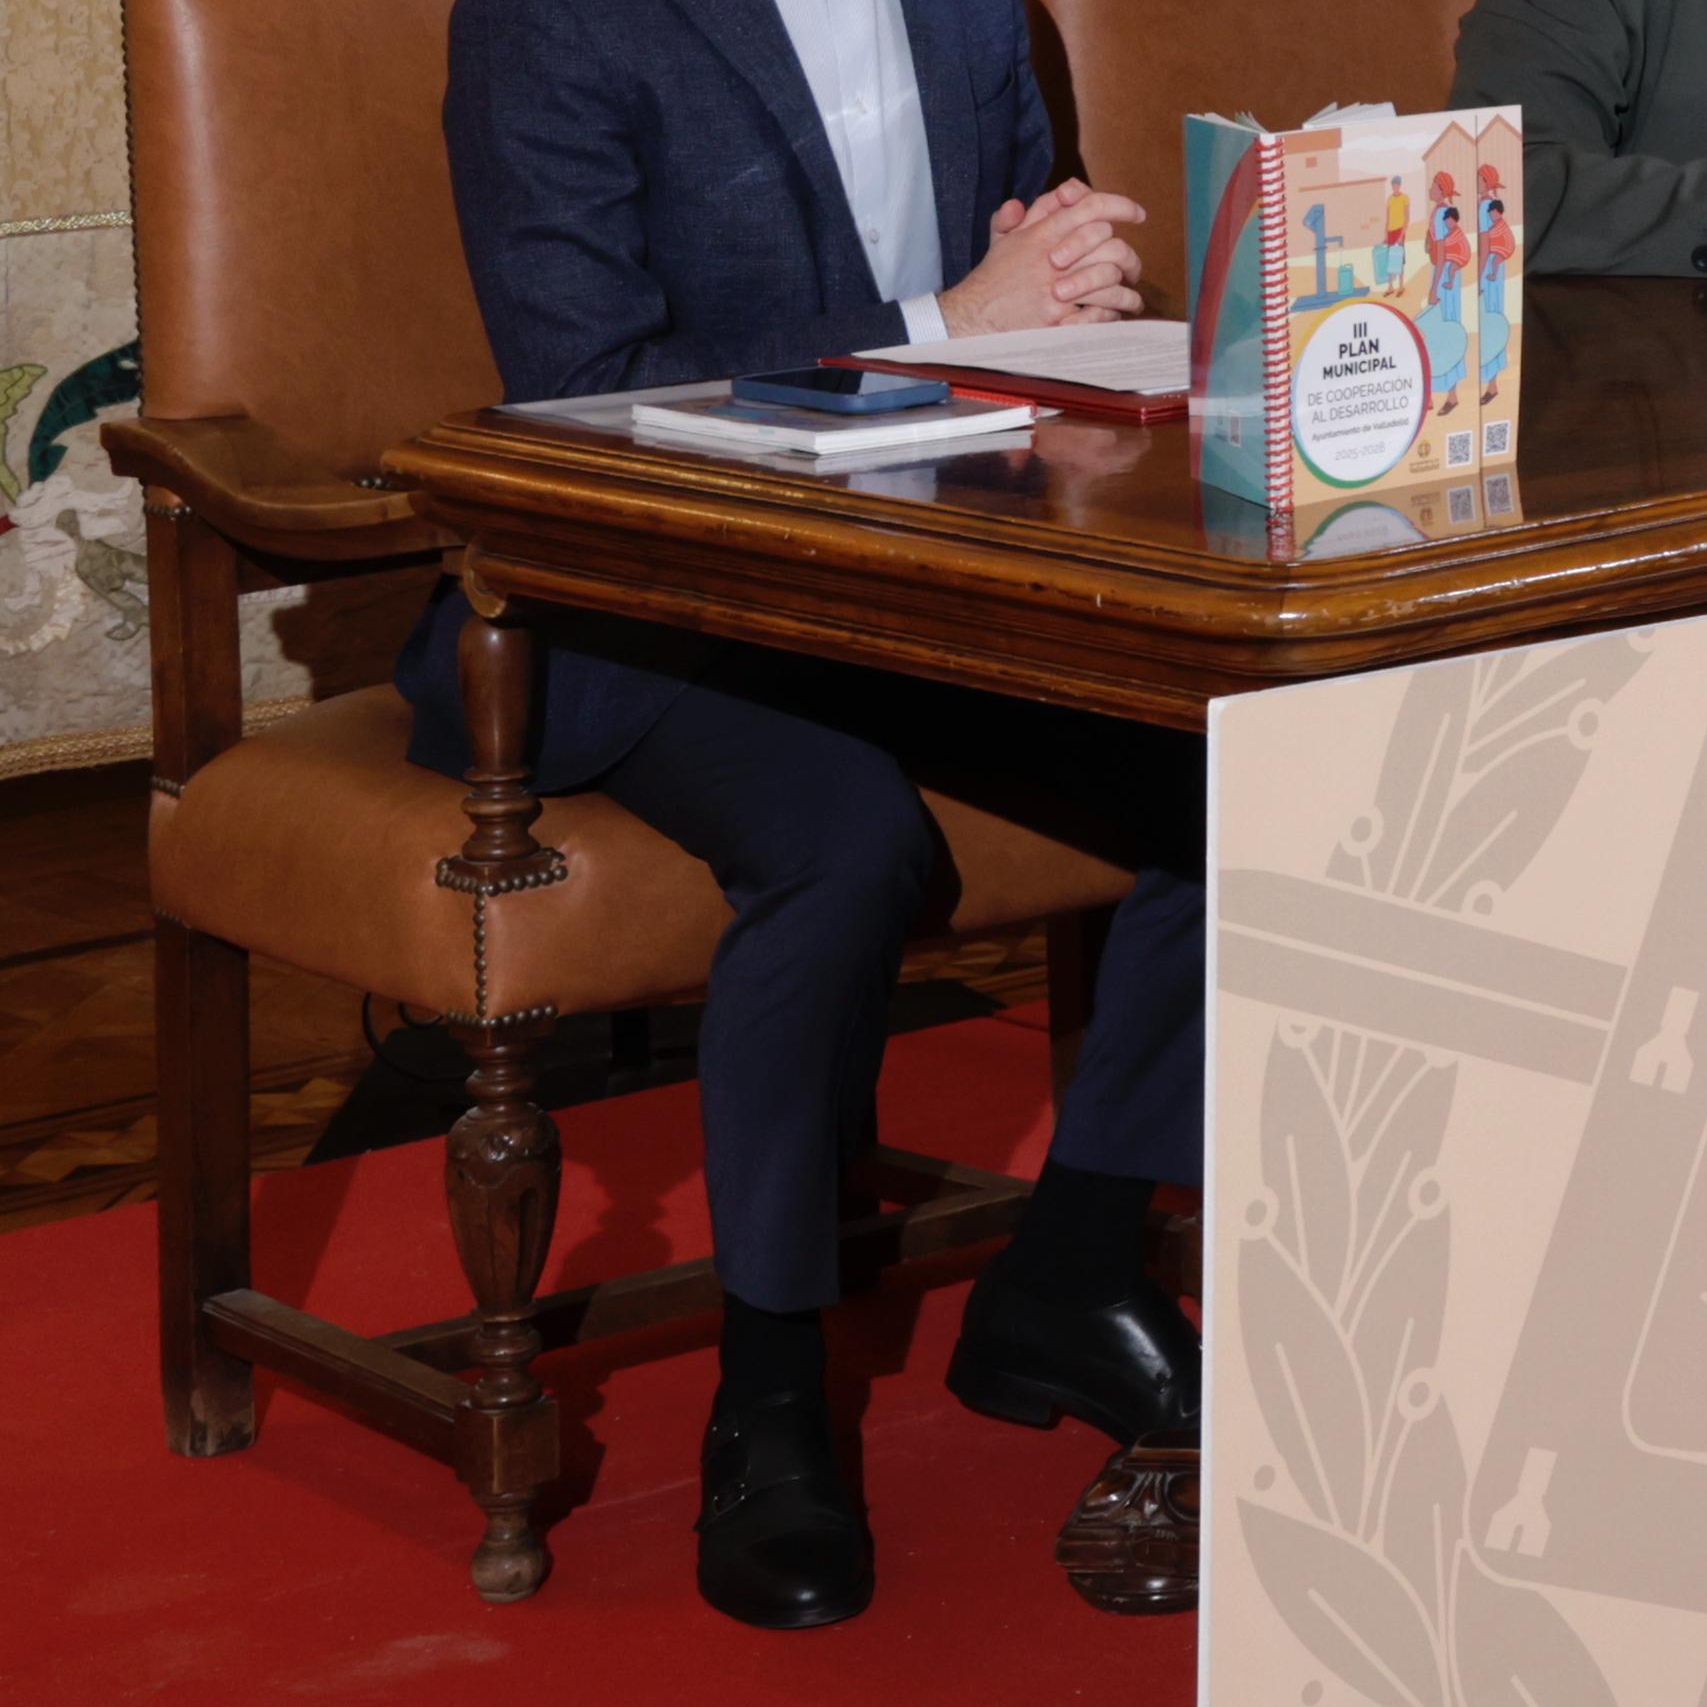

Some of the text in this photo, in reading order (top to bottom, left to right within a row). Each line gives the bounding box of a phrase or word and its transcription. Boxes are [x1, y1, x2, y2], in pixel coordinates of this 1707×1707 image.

[1354, 322, 1367, 338] III
[1339, 338, 1379, 359] PLAN
[1323, 356, 1396, 380] MUNICIPAL
[1308, 392, 1322, 406] DE
[1312, 396, 1408, 424] AL DESARROLLO
[1312, 417, 1409, 442] Ayuntamiento de Valladolid
